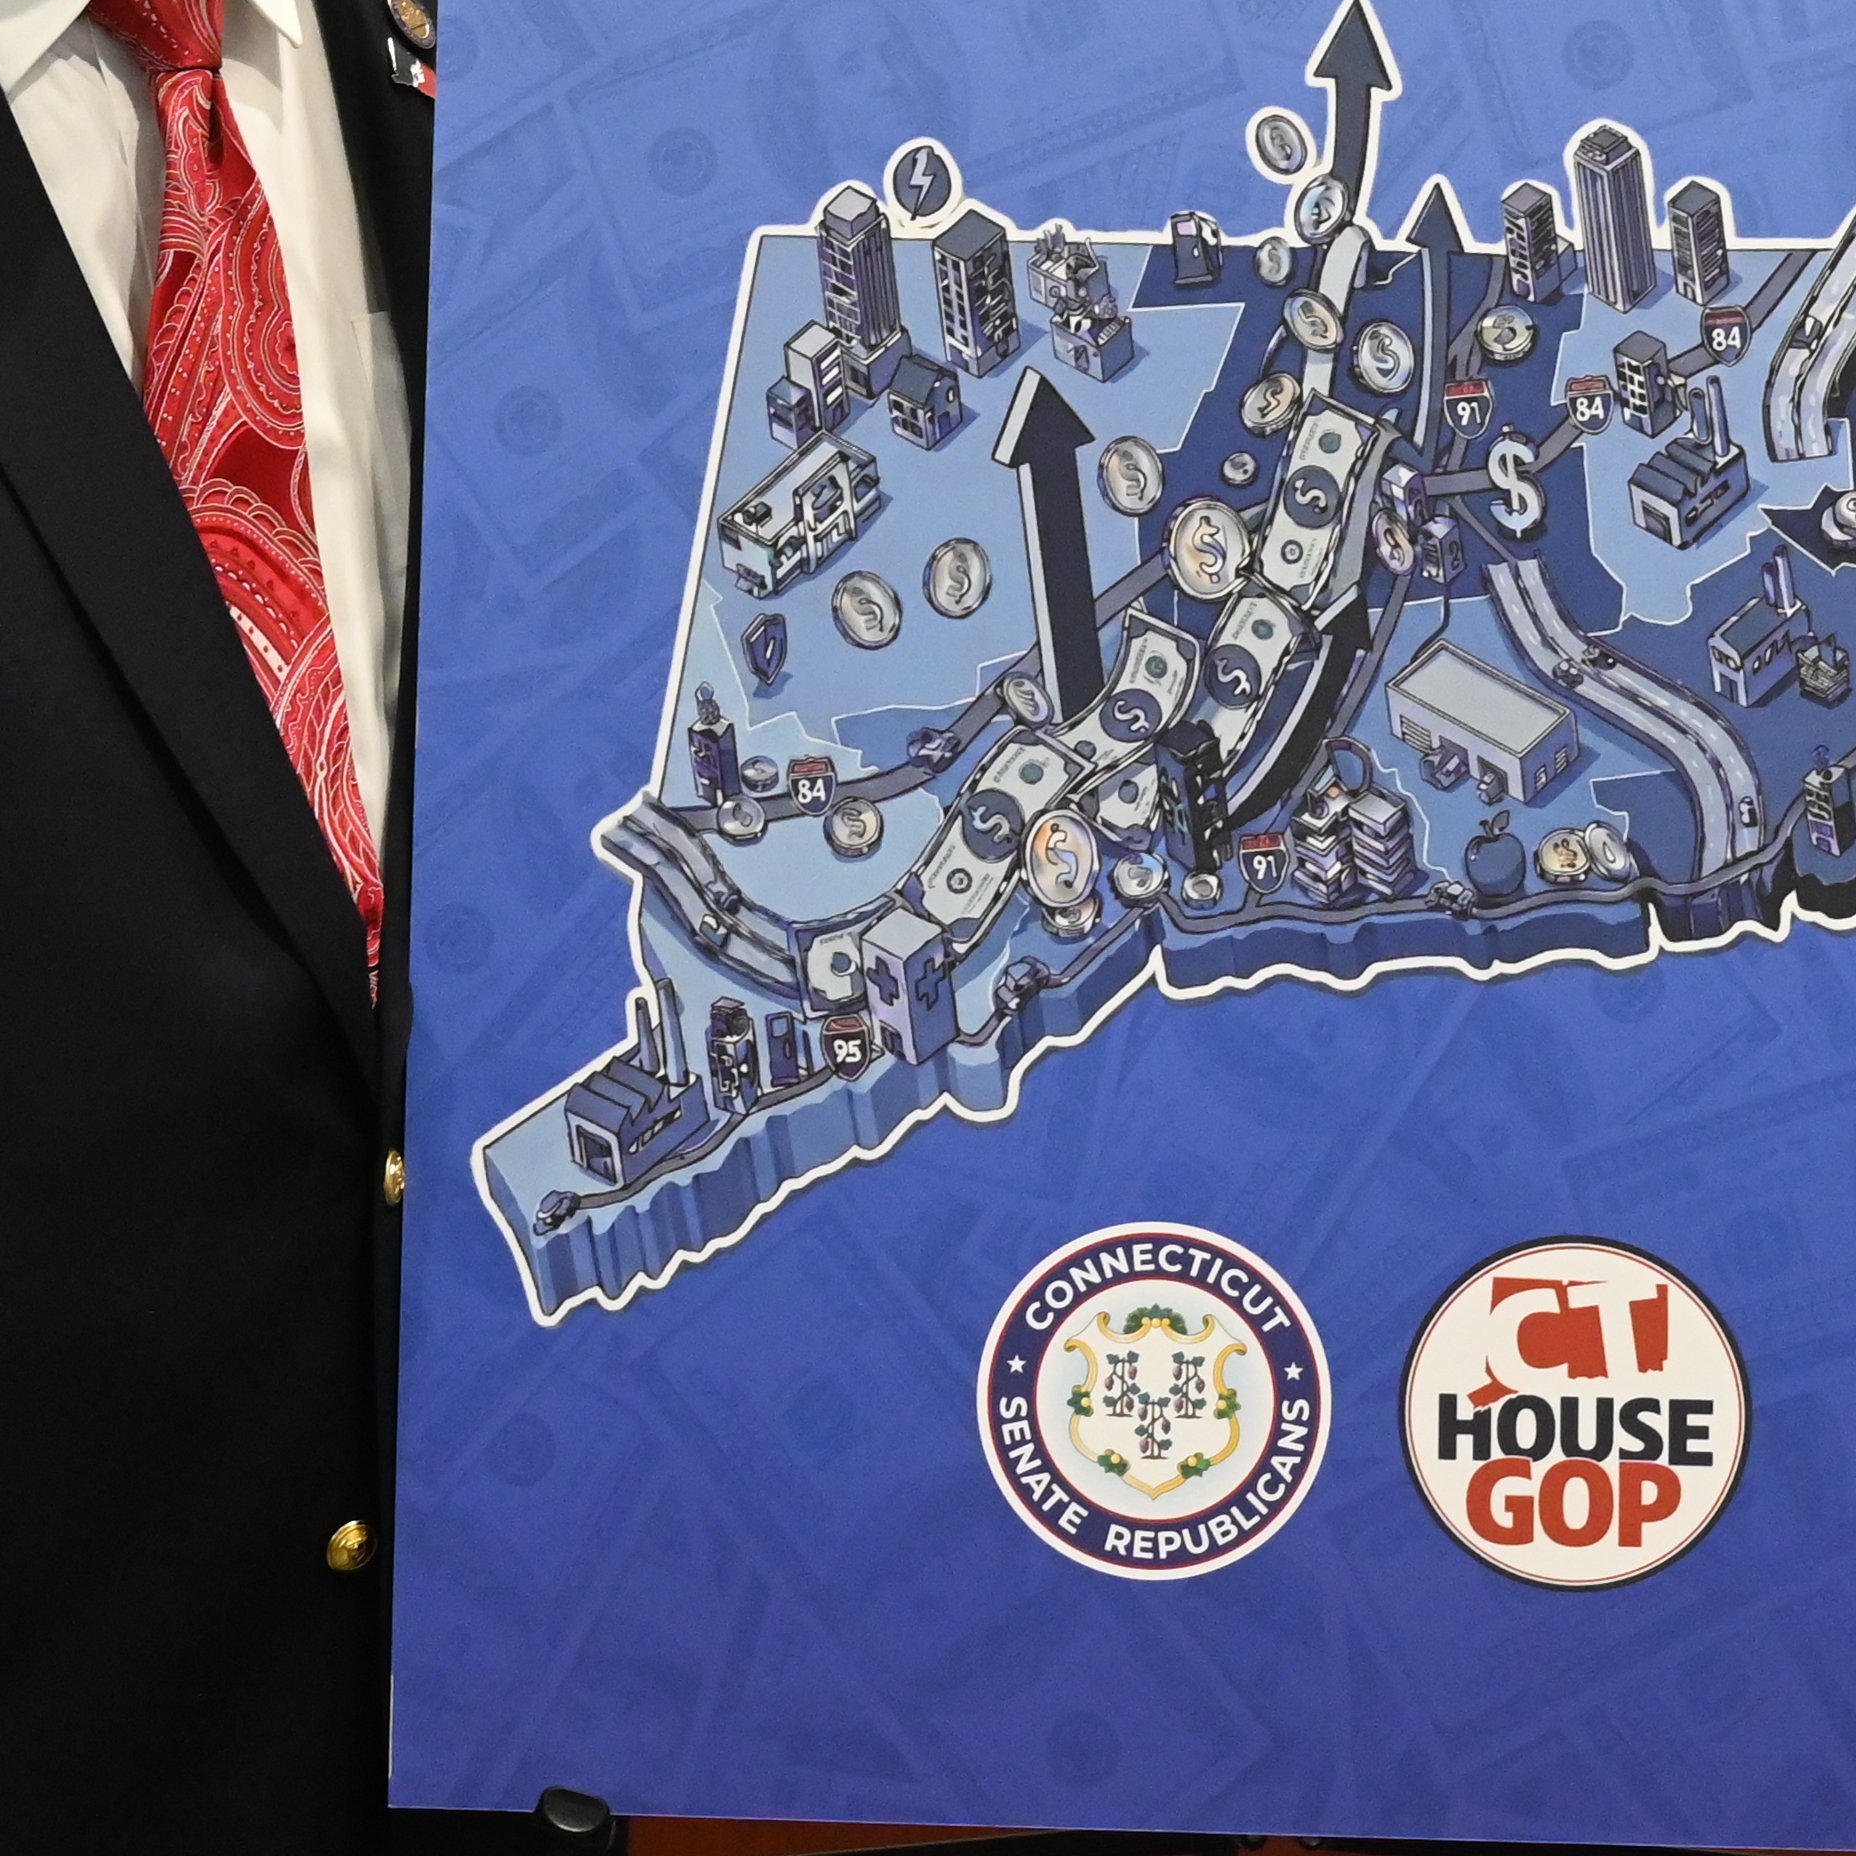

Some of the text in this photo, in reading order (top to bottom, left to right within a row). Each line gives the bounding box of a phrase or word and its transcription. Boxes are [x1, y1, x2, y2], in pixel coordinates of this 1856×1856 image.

[1711, 326, 1741, 351] 84
[1456, 400, 1482, 427] 91
[1575, 396, 1605, 423] 84
[797, 778, 826, 804] 84
[1253, 855, 1277, 880] 91
[833, 1038, 862, 1063] 95
[1025, 1242, 1292, 1334] CONNECTICUT
[1481, 1276, 1669, 1400] CT
[1438, 1392, 1714, 1467] HOUSE
[999, 1395, 1311, 1560] SENATE REPUBLICANS
[1465, 1456, 1682, 1548] GOP
